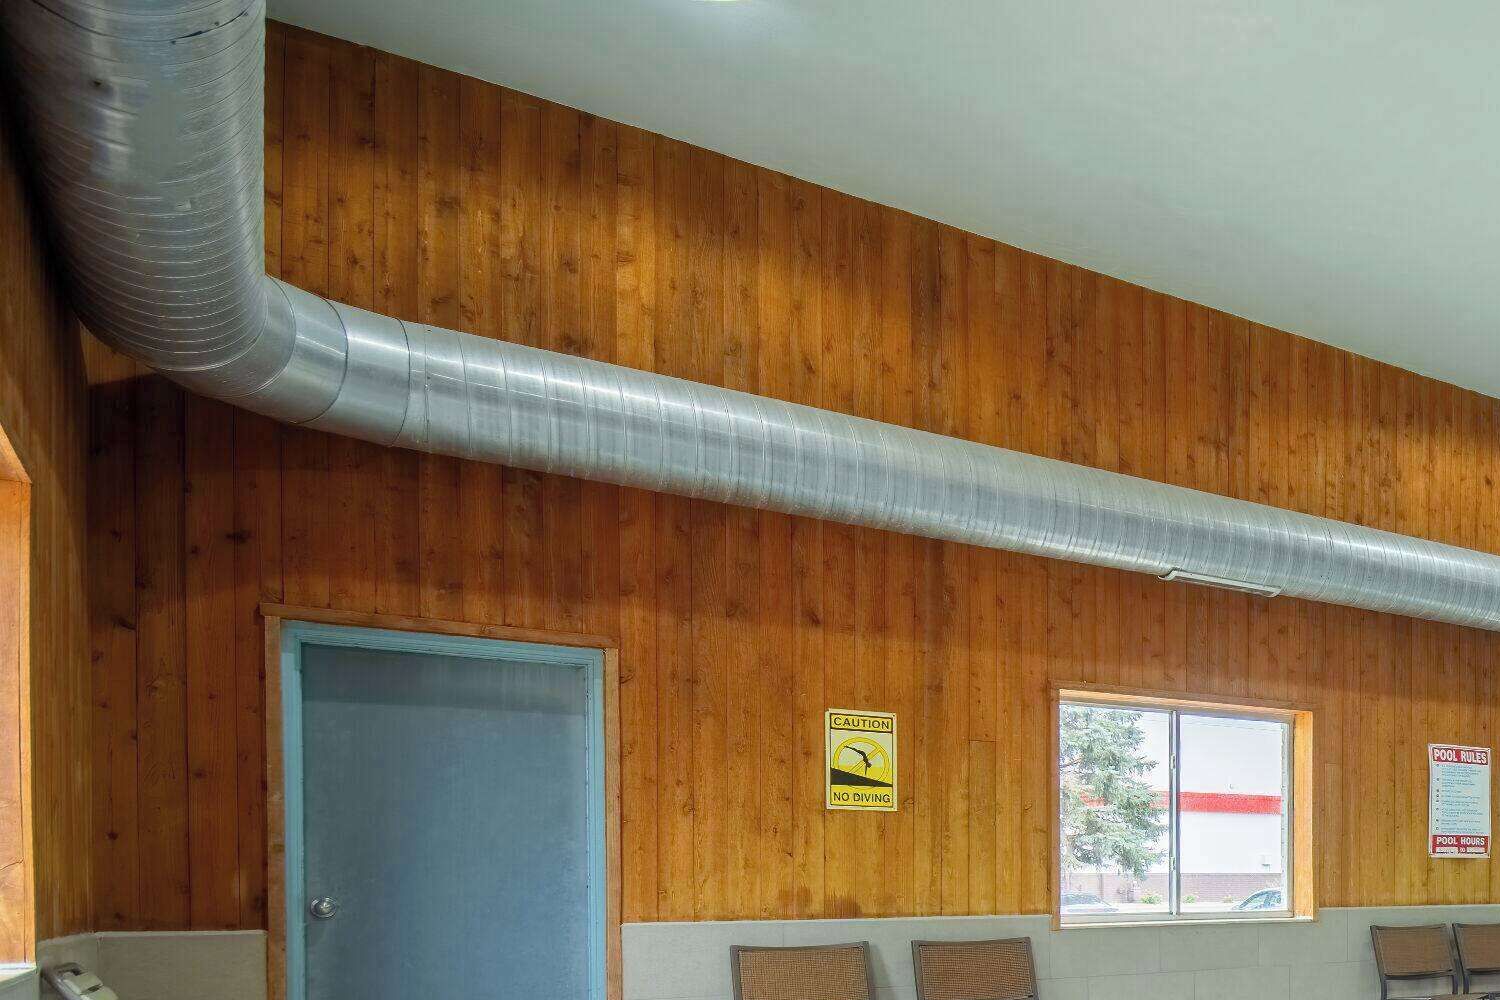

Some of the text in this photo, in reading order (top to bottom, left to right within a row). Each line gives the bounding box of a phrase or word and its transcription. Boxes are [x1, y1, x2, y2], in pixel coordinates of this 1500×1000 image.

[834, 717, 889, 730] CAUTION
[1434, 749, 1487, 764] POOL RULES
[834, 792, 891, 803] NO DIVING
[1436, 836, 1485, 846] POOL HOURS
